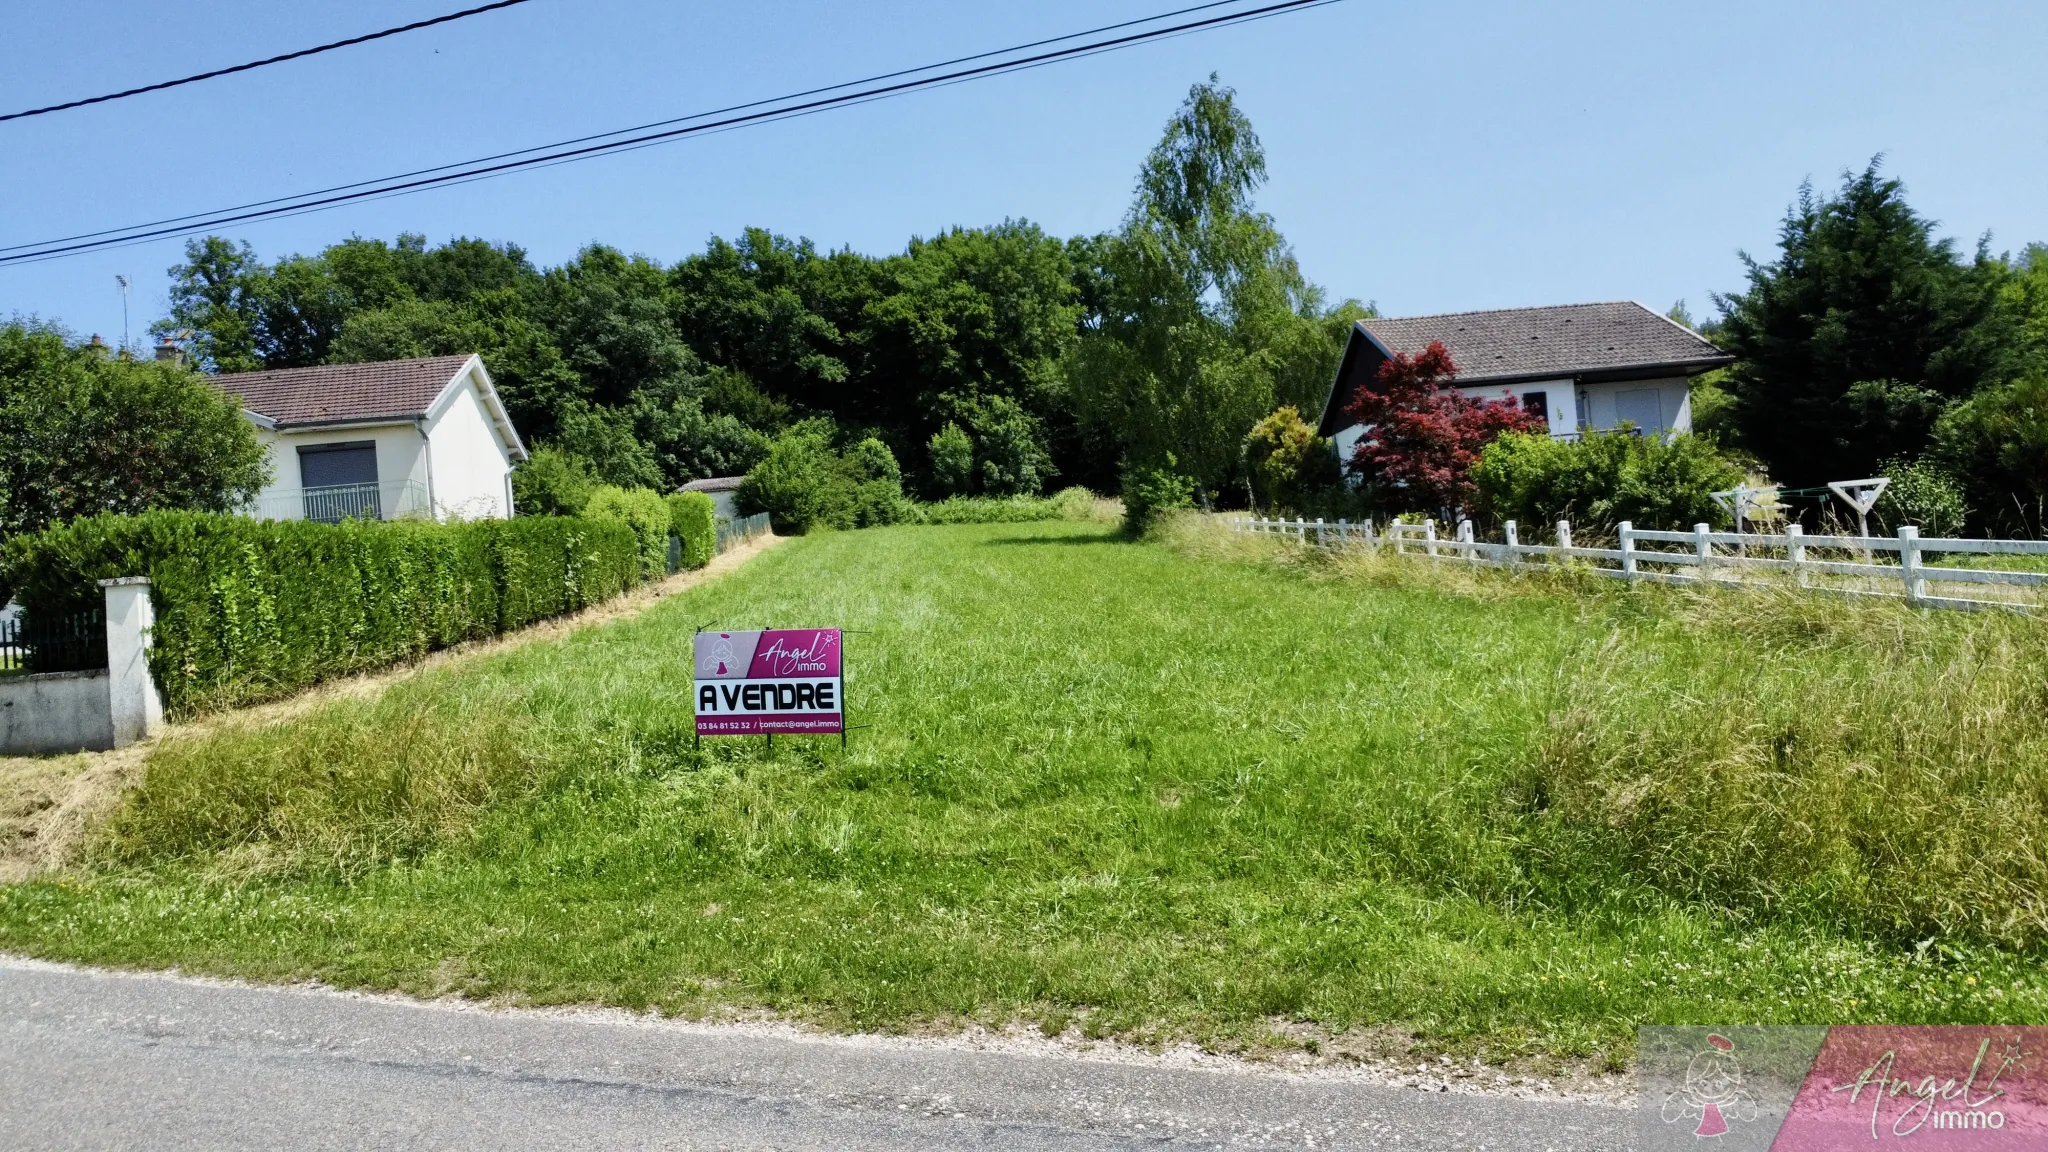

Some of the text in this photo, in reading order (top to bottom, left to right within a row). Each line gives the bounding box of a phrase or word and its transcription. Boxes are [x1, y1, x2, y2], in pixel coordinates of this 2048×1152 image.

[758, 632, 826, 676] Angel
[797, 661, 827, 672] immo
[699, 684, 718, 712] A
[697, 722, 707, 730] 03
[708, 722, 719, 730] 84
[719, 722, 729, 730] 81
[729, 721, 740, 730] 52
[740, 721, 751, 729] 32
[759, 720, 840, 729] contact@angel.immo
